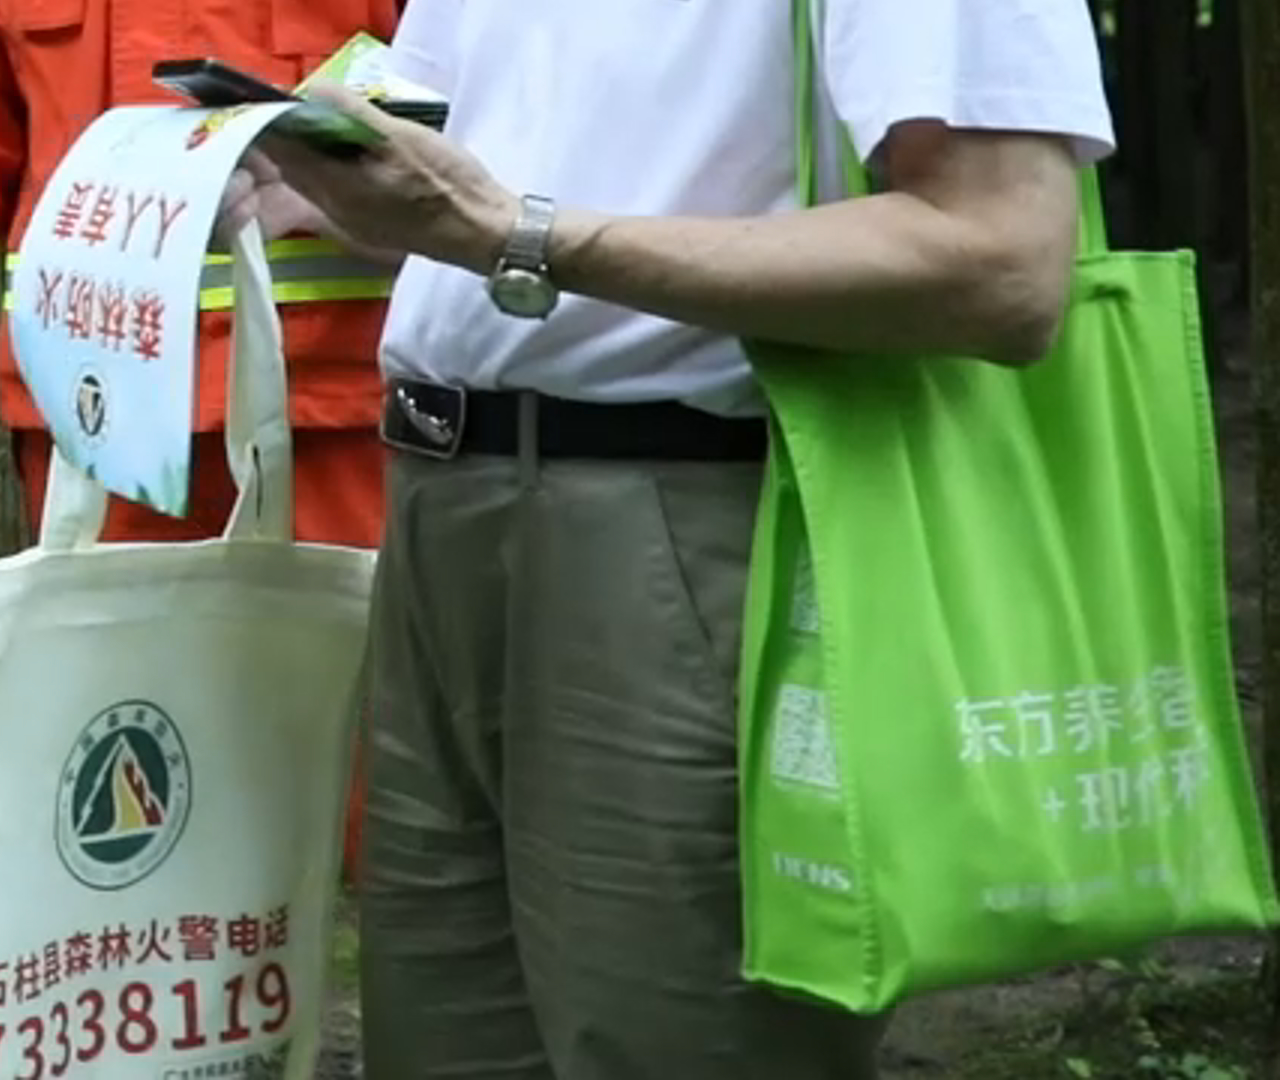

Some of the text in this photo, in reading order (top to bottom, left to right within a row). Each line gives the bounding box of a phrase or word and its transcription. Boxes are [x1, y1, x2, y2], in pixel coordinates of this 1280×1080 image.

[53, 181, 188, 260] 人人有责
[35, 267, 165, 363] 森林防火
